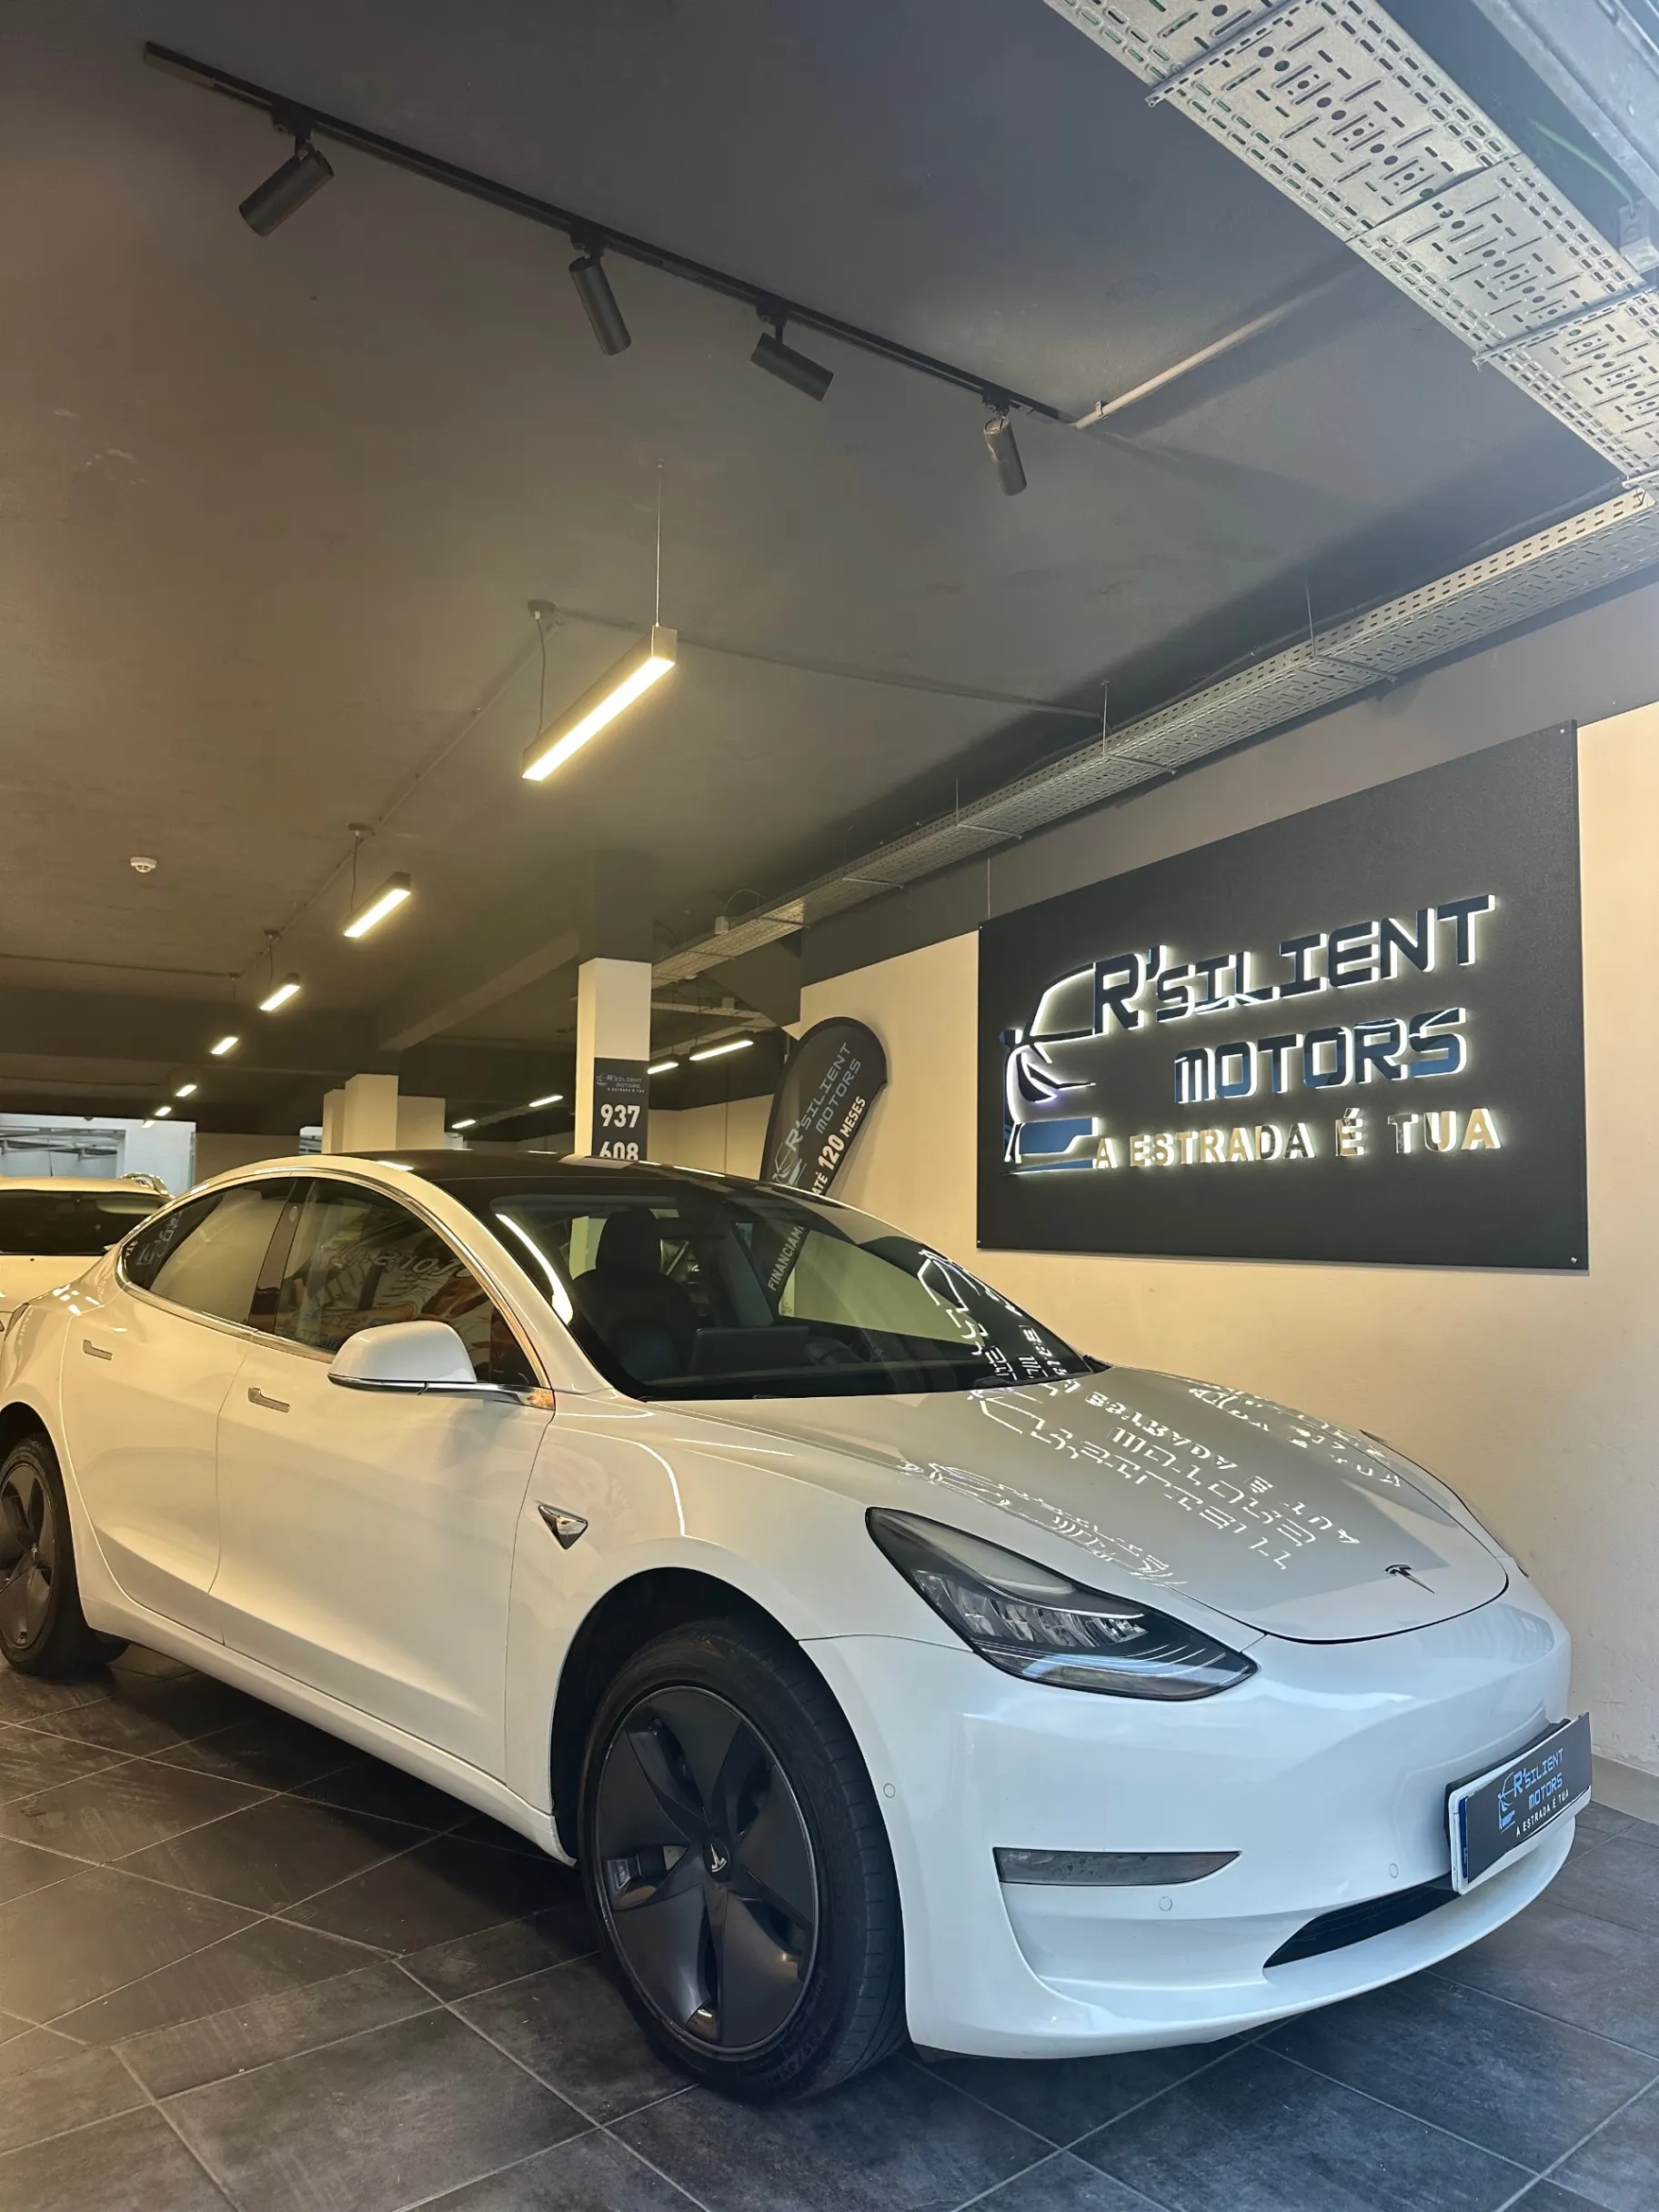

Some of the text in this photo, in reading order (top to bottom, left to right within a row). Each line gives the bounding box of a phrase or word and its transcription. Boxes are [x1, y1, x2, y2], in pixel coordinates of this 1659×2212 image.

[1093, 894, 1495, 1035] R'SILIENT
[1173, 1007, 1466, 1103] MOTORS
[600, 1103, 640, 1128] 937
[785, 1042, 850, 1152] R'SILIENT
[816, 1058, 861, 1134] MOTORS
[599, 1141, 639, 1161] 608
[1093, 1107, 1502, 1169] A ESTRADA É TUA
[767, 1096, 866, 1292] FINANCIAM ATÉ 120 MESES
[1513, 1748, 1563, 1797] R'SILIENT
[1528, 1773, 1563, 1810] MOTORS
[1516, 1788, 1569, 1837] A ESTRADA É TUA
